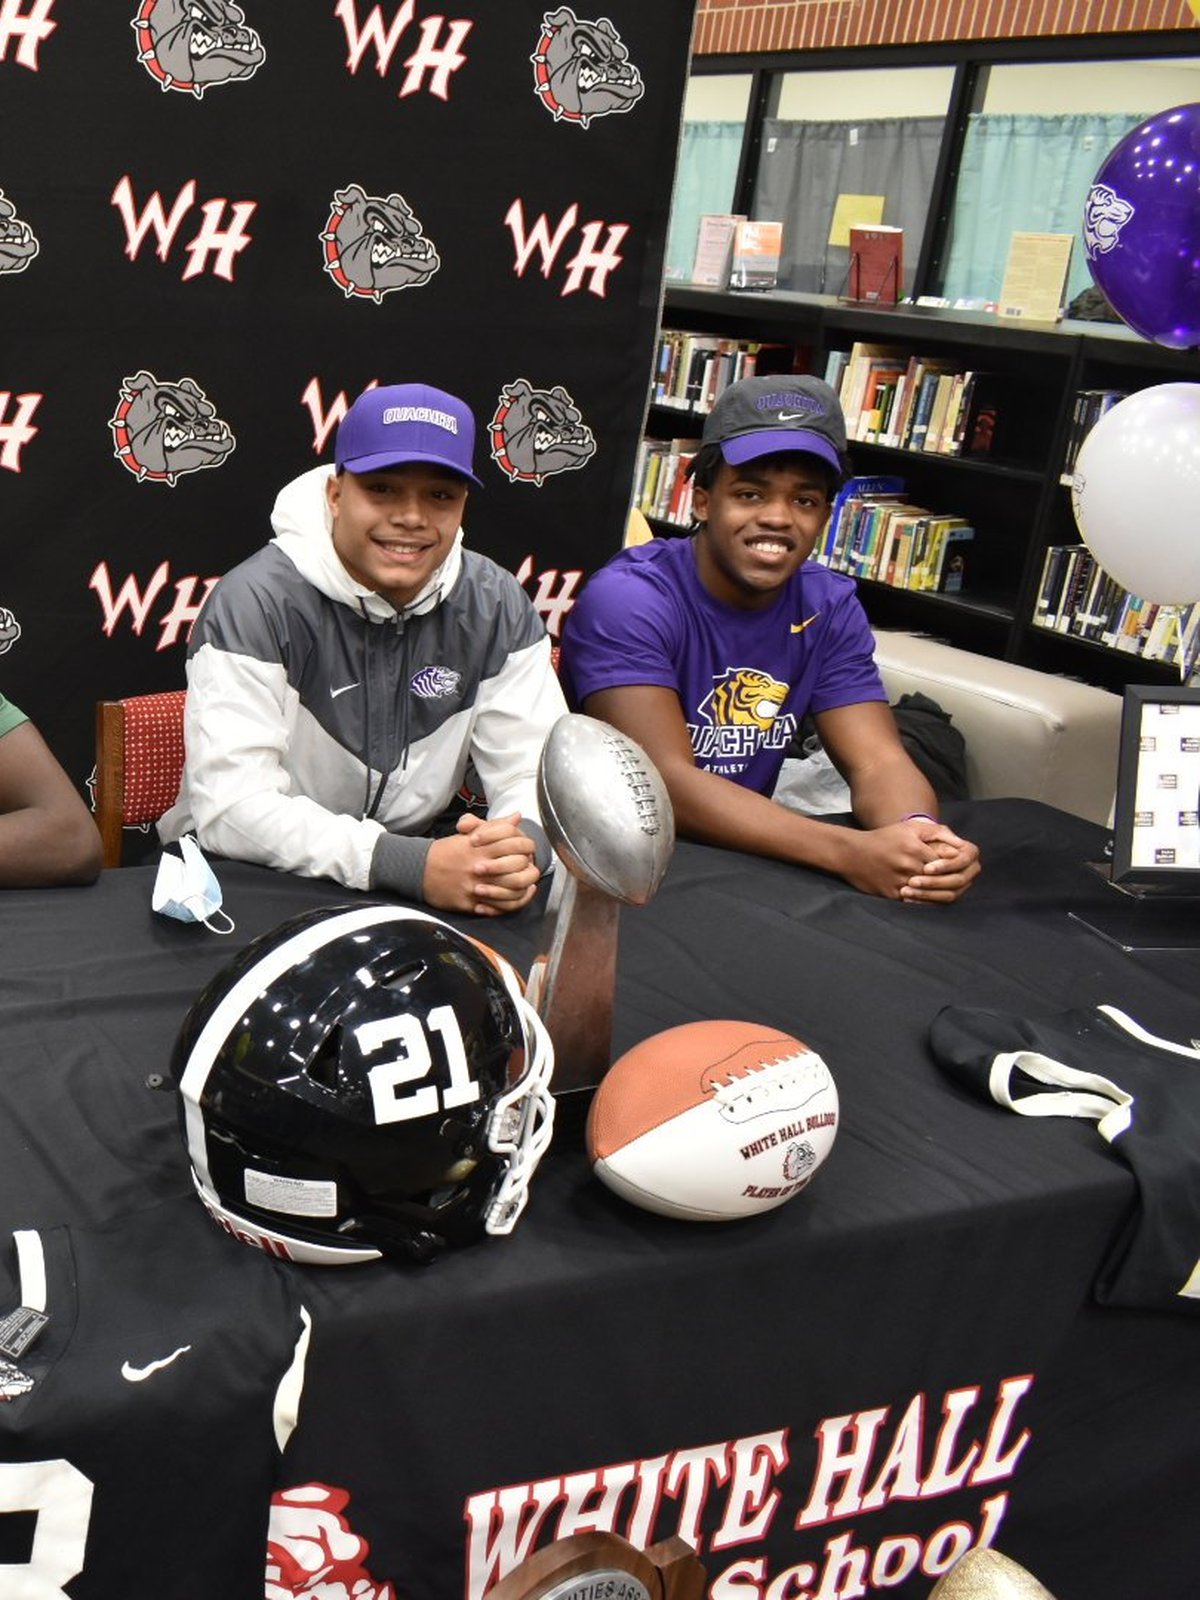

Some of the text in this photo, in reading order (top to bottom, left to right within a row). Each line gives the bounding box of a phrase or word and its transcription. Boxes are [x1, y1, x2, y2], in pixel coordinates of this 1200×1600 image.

[334, 0, 474, 101] WH
[111, 176, 257, 282] WH
[504, 198, 629, 298] WH
[353, 1005, 481, 1126] 21
[739, 1132, 778, 1161] WHITE
[778, 1121, 806, 1143] HALL
[741, 1184, 782, 1199] PLAYER
[464, 1374, 1035, 1600] WHITE HALL
